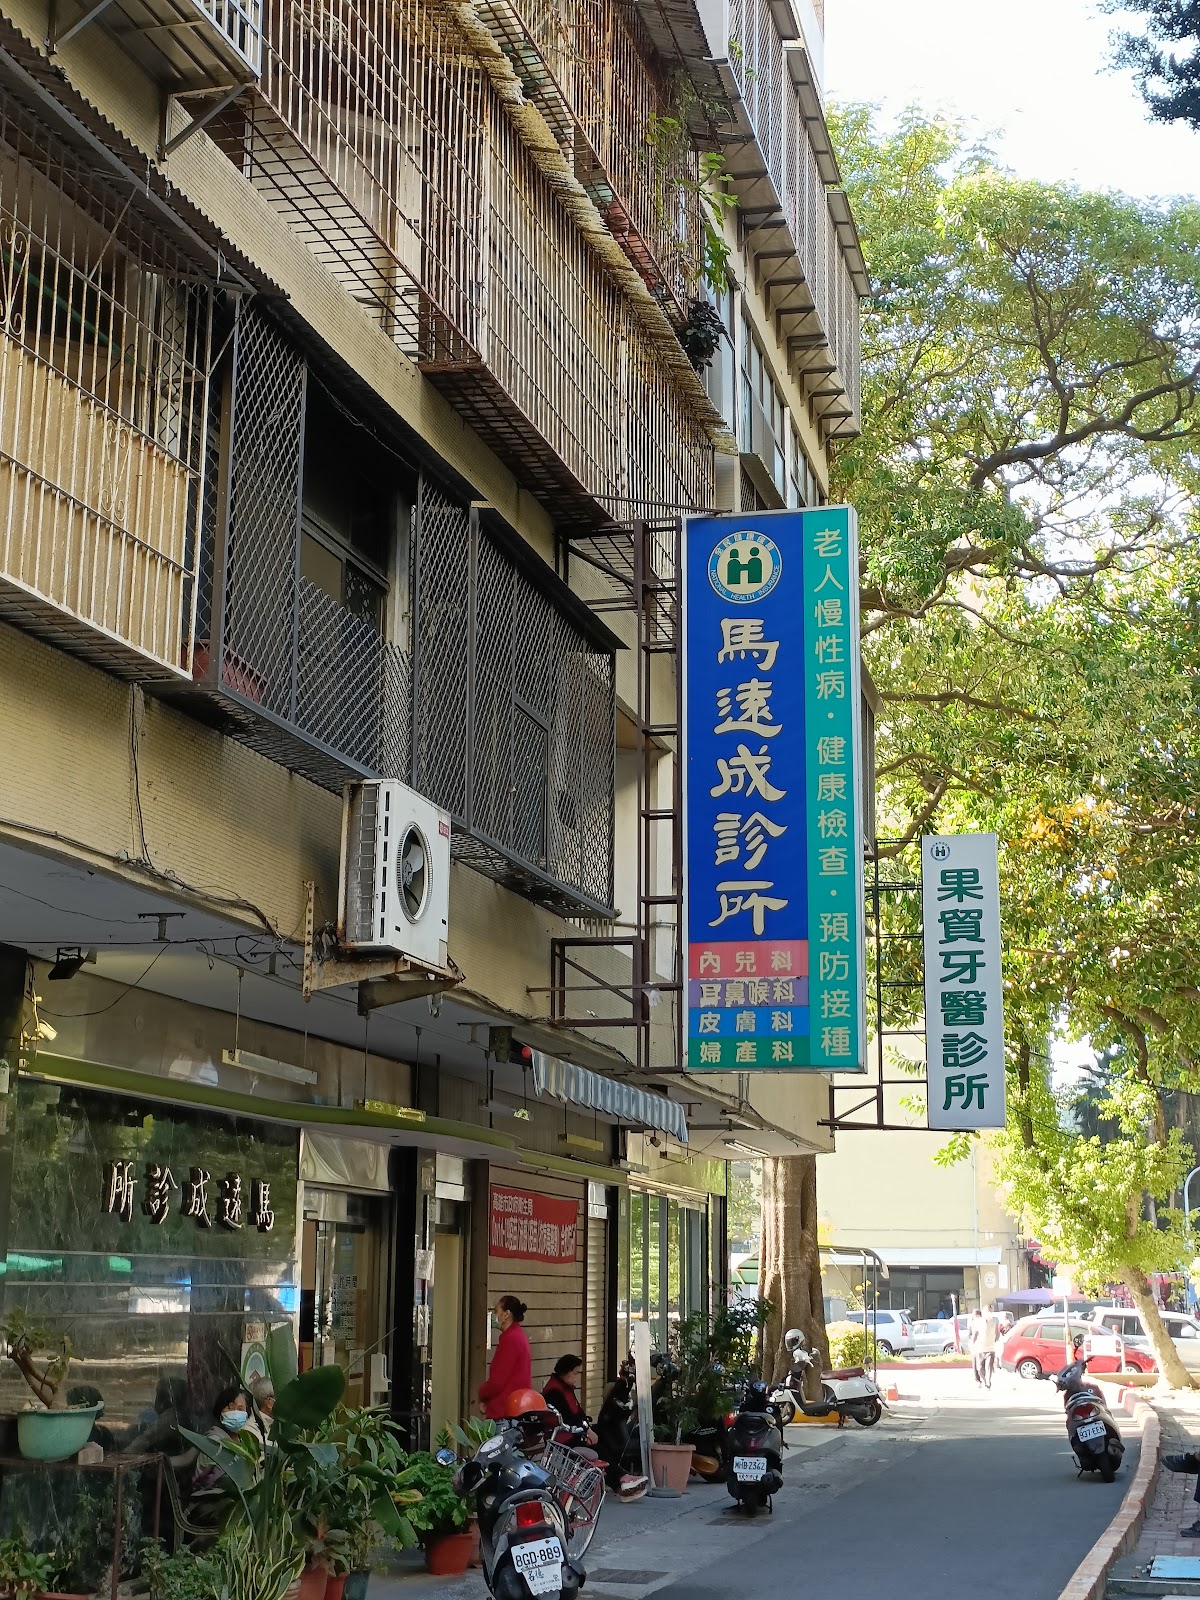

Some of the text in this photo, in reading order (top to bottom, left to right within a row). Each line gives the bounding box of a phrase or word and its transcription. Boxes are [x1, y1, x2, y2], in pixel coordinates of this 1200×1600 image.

[711, 565, 780, 601] NATIONAL HEALTH INSURANCE
[708, 617, 788, 936] 馬遠成診所
[700, 981, 795, 1007] 耳鼻喉科
[937, 868, 989, 1111] 果貿牙醫診所
[699, 1010, 793, 1033] 皮膚科
[700, 1041, 794, 1064] 婦產科
